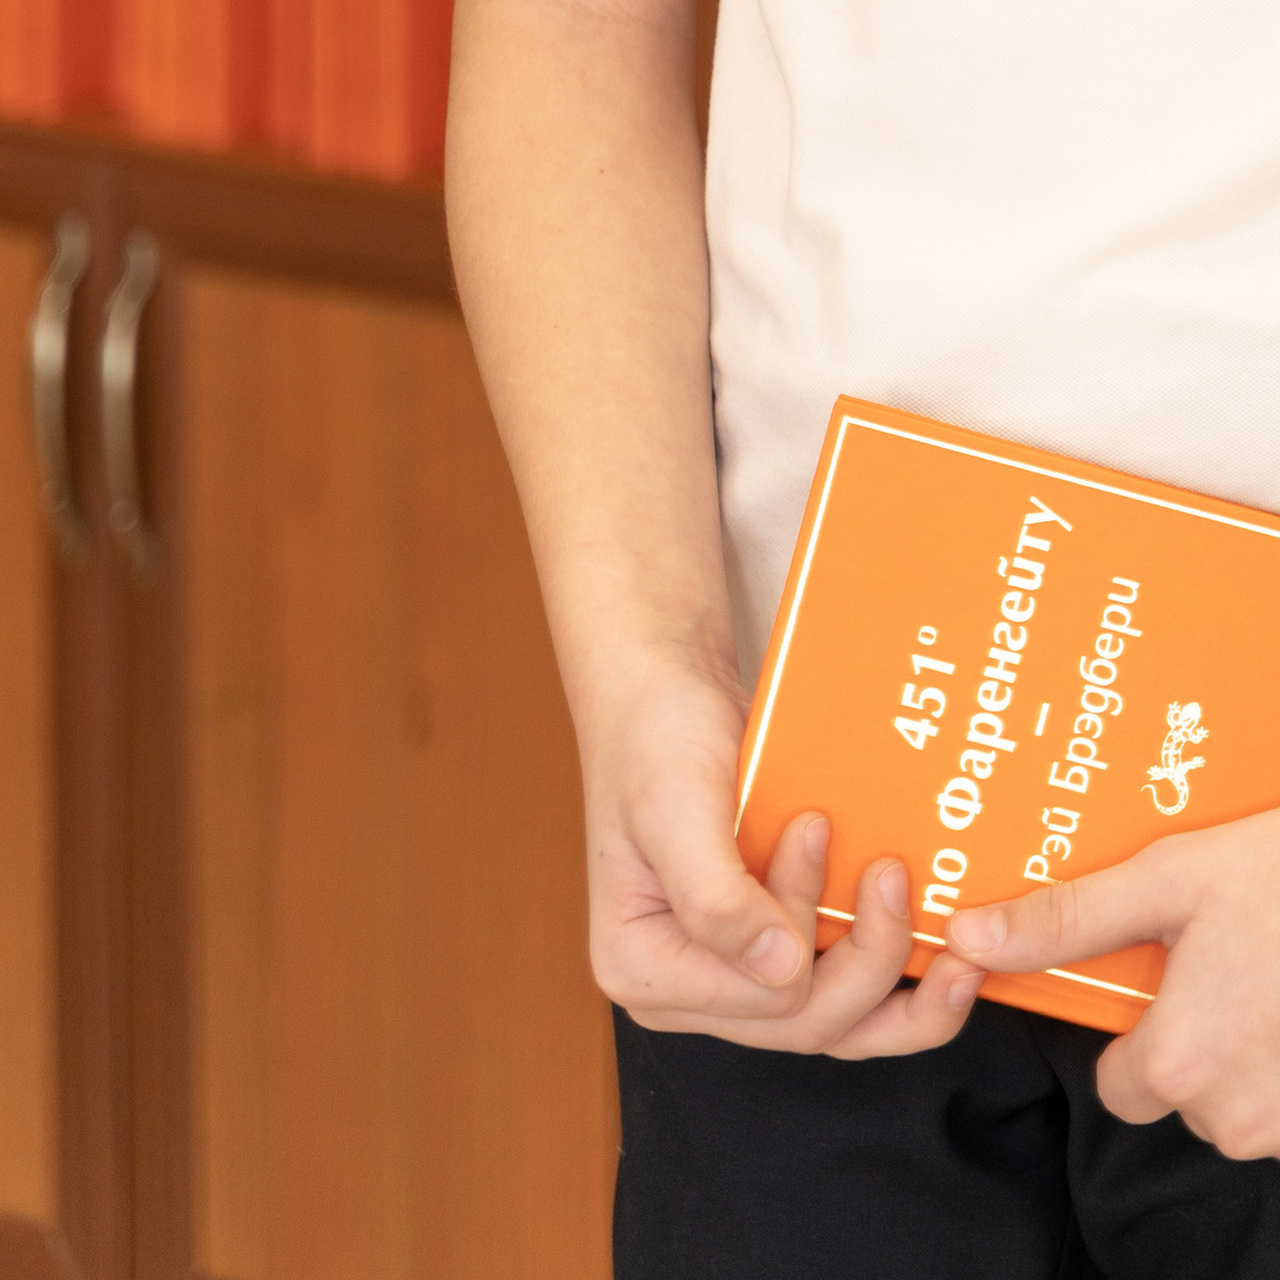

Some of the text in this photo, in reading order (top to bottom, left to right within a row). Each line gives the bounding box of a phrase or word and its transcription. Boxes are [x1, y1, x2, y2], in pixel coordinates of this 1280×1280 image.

[922, 495, 1073, 917] по Фаренгейту
[1023, 576, 1143, 885] Рэй Брэдбери
